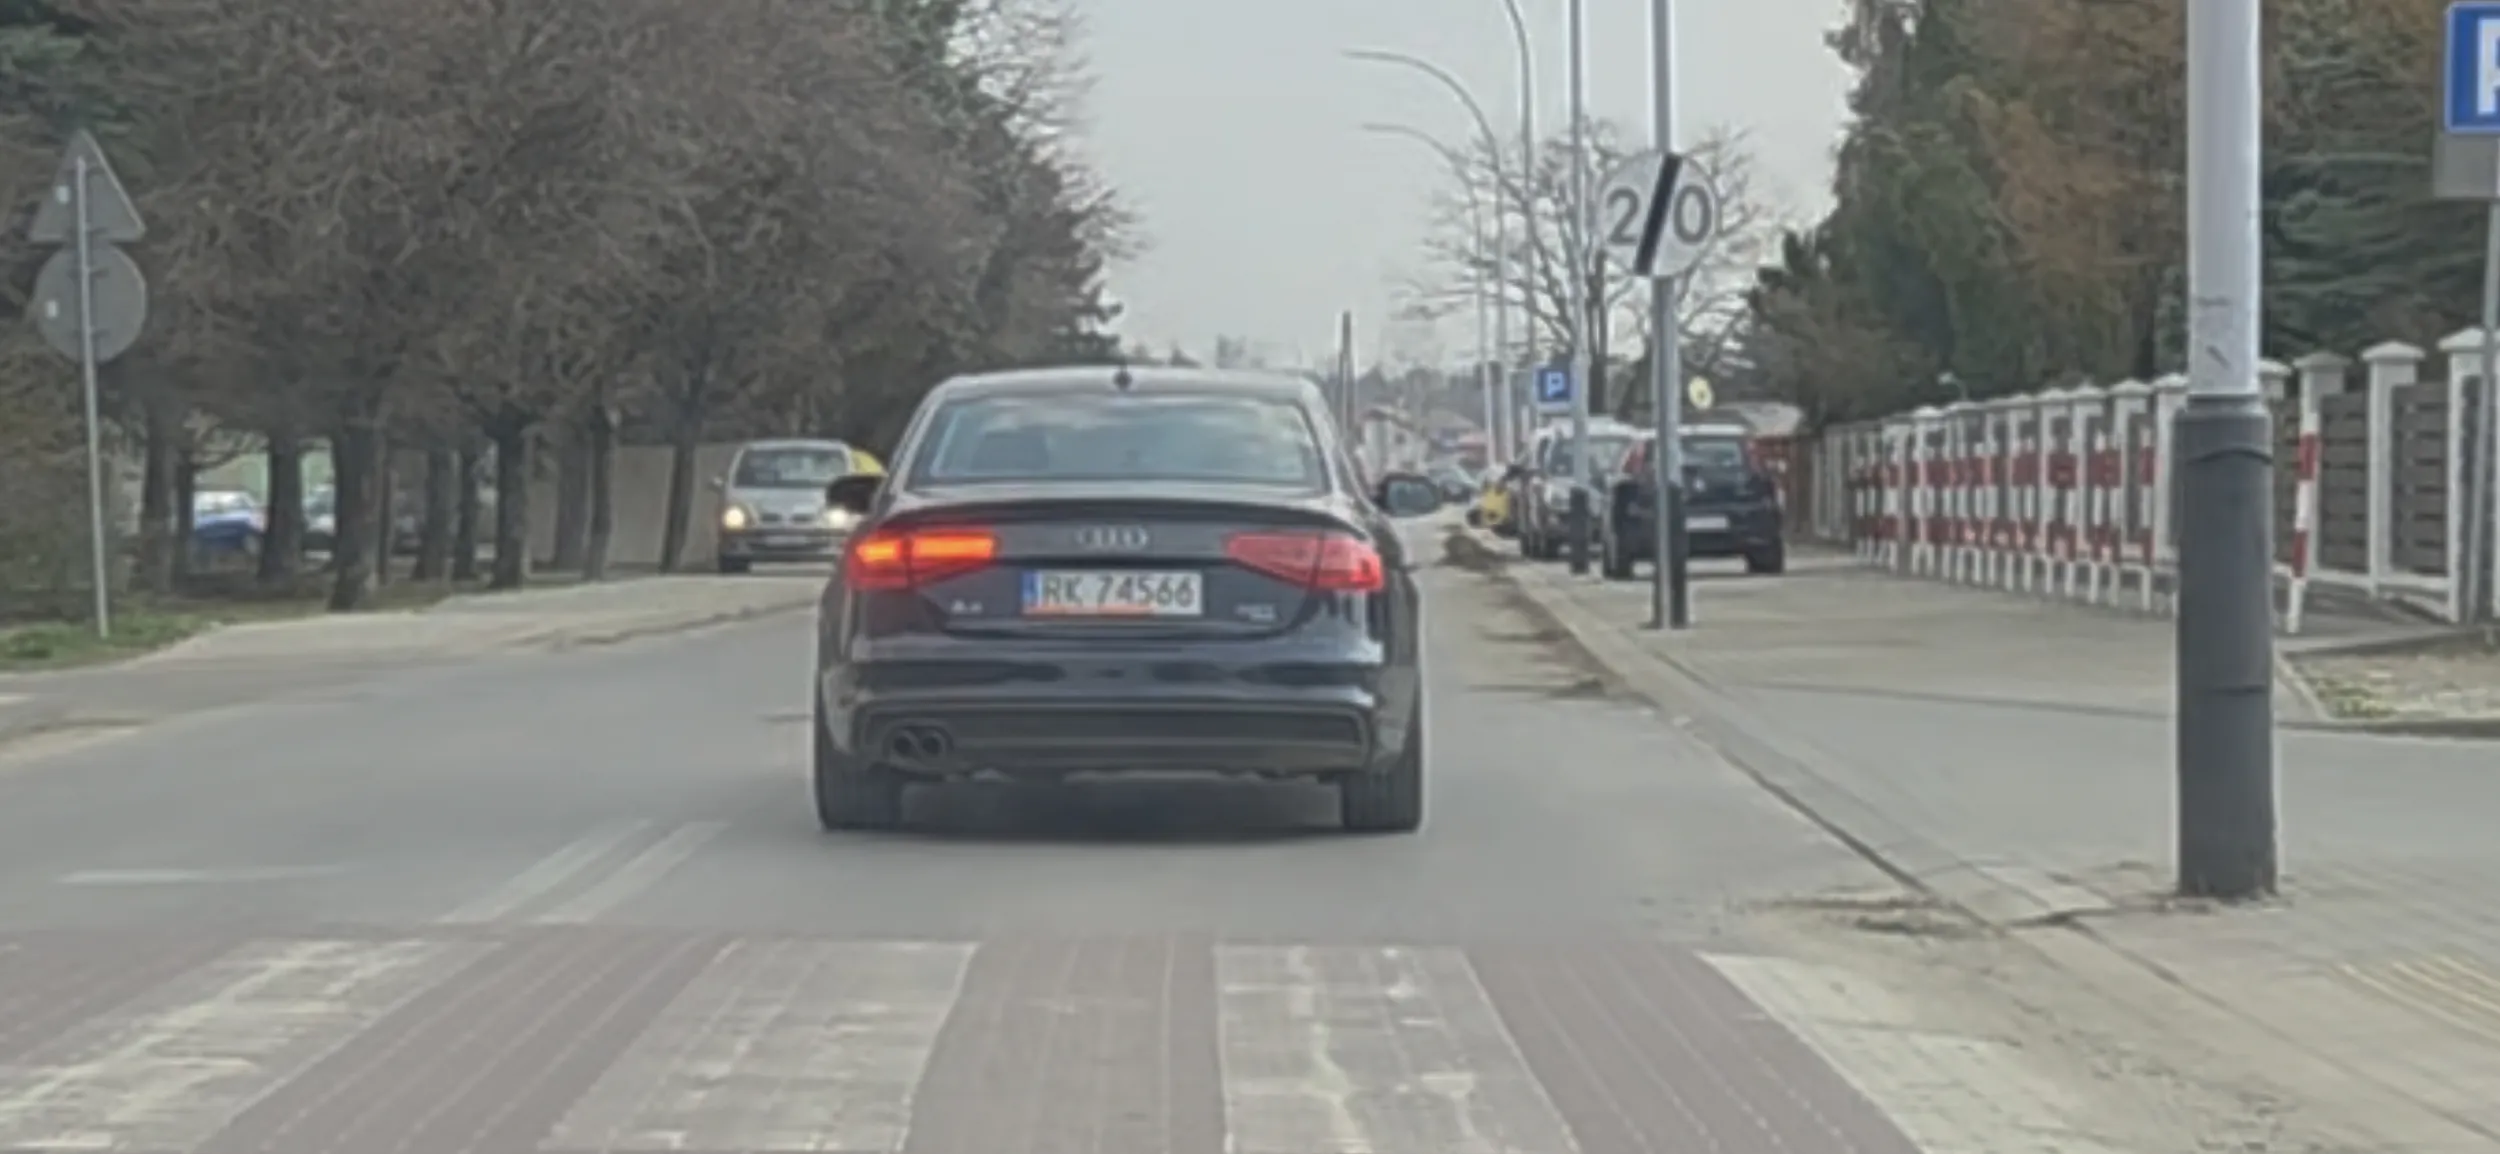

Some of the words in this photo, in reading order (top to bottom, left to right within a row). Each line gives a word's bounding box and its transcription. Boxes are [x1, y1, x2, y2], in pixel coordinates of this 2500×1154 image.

[1606, 186, 1712, 246] 20
[1547, 371, 1564, 397] P
[1046, 575, 1083, 606] RK
[1097, 575, 1195, 608] 74566
